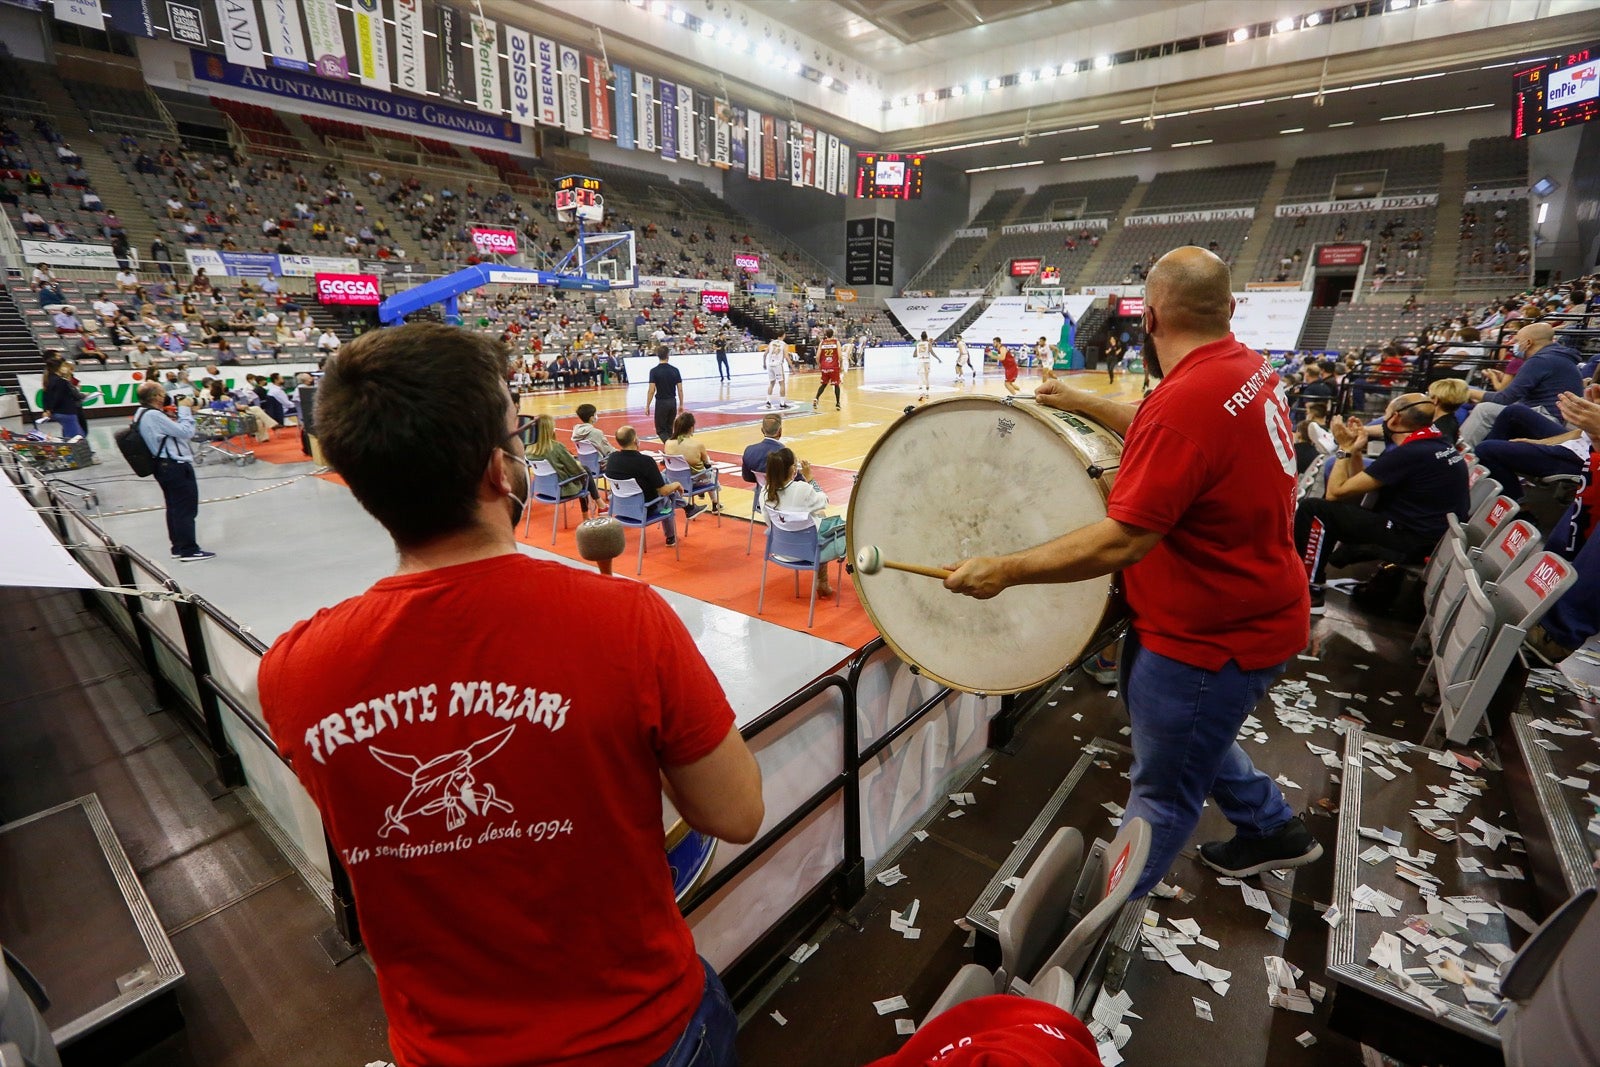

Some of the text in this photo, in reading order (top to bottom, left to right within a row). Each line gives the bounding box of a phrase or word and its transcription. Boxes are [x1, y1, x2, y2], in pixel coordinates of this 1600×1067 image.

[400, 14, 416, 88] NEPTUNO
[443, 11, 455, 88] HOTEL LUNA
[511, 35, 528, 100] asisa
[1567, 50, 1590, 65] 2:17
[480, 40, 494, 110] fertisac
[540, 41, 554, 106] BERNER
[1529, 71, 1540, 82] 19
[1549, 82, 1577, 100] enPie
[241, 66, 495, 136] AYUNTAMIENTO DE GRANADA
[568, 74, 578, 118] Cuerva
[1004, 219, 1104, 235] IDEAL IDEAL IDEAL
[1128, 210, 1247, 226] IDEAL IDEAL IDEAL
[1280, 197, 1427, 216] IDEAL IDEAL IDEAL
[1223, 372, 1264, 417] FRENTE
[1509, 528, 1521, 545] NO
[1535, 562, 1553, 581] NO
[304, 682, 438, 765] FRENTE
[342, 818, 573, 865] Un sentimiento desde 1994
